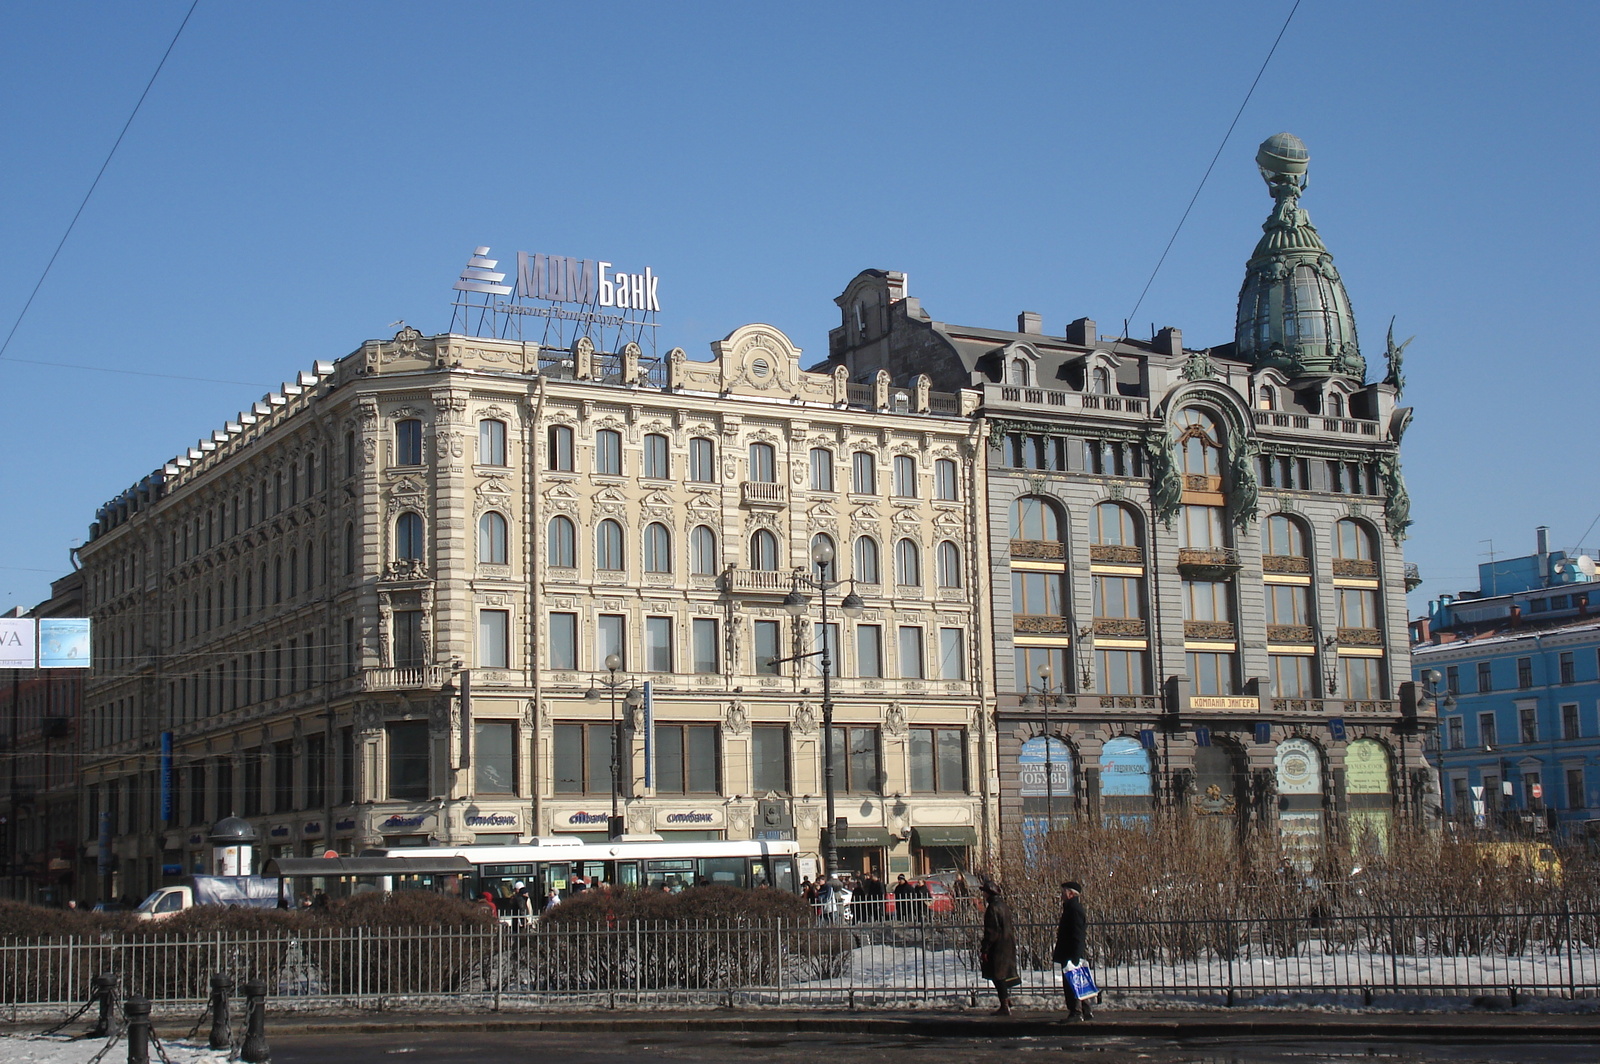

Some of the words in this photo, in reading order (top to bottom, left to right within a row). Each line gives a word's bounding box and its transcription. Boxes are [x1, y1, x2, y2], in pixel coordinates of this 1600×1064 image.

[516, 251, 594, 305] МДМ
[597, 261, 660, 312] Банк
[1023, 764, 1066, 772] МАТТНО
[1024, 773, 1065, 784] ОБУВЬ
